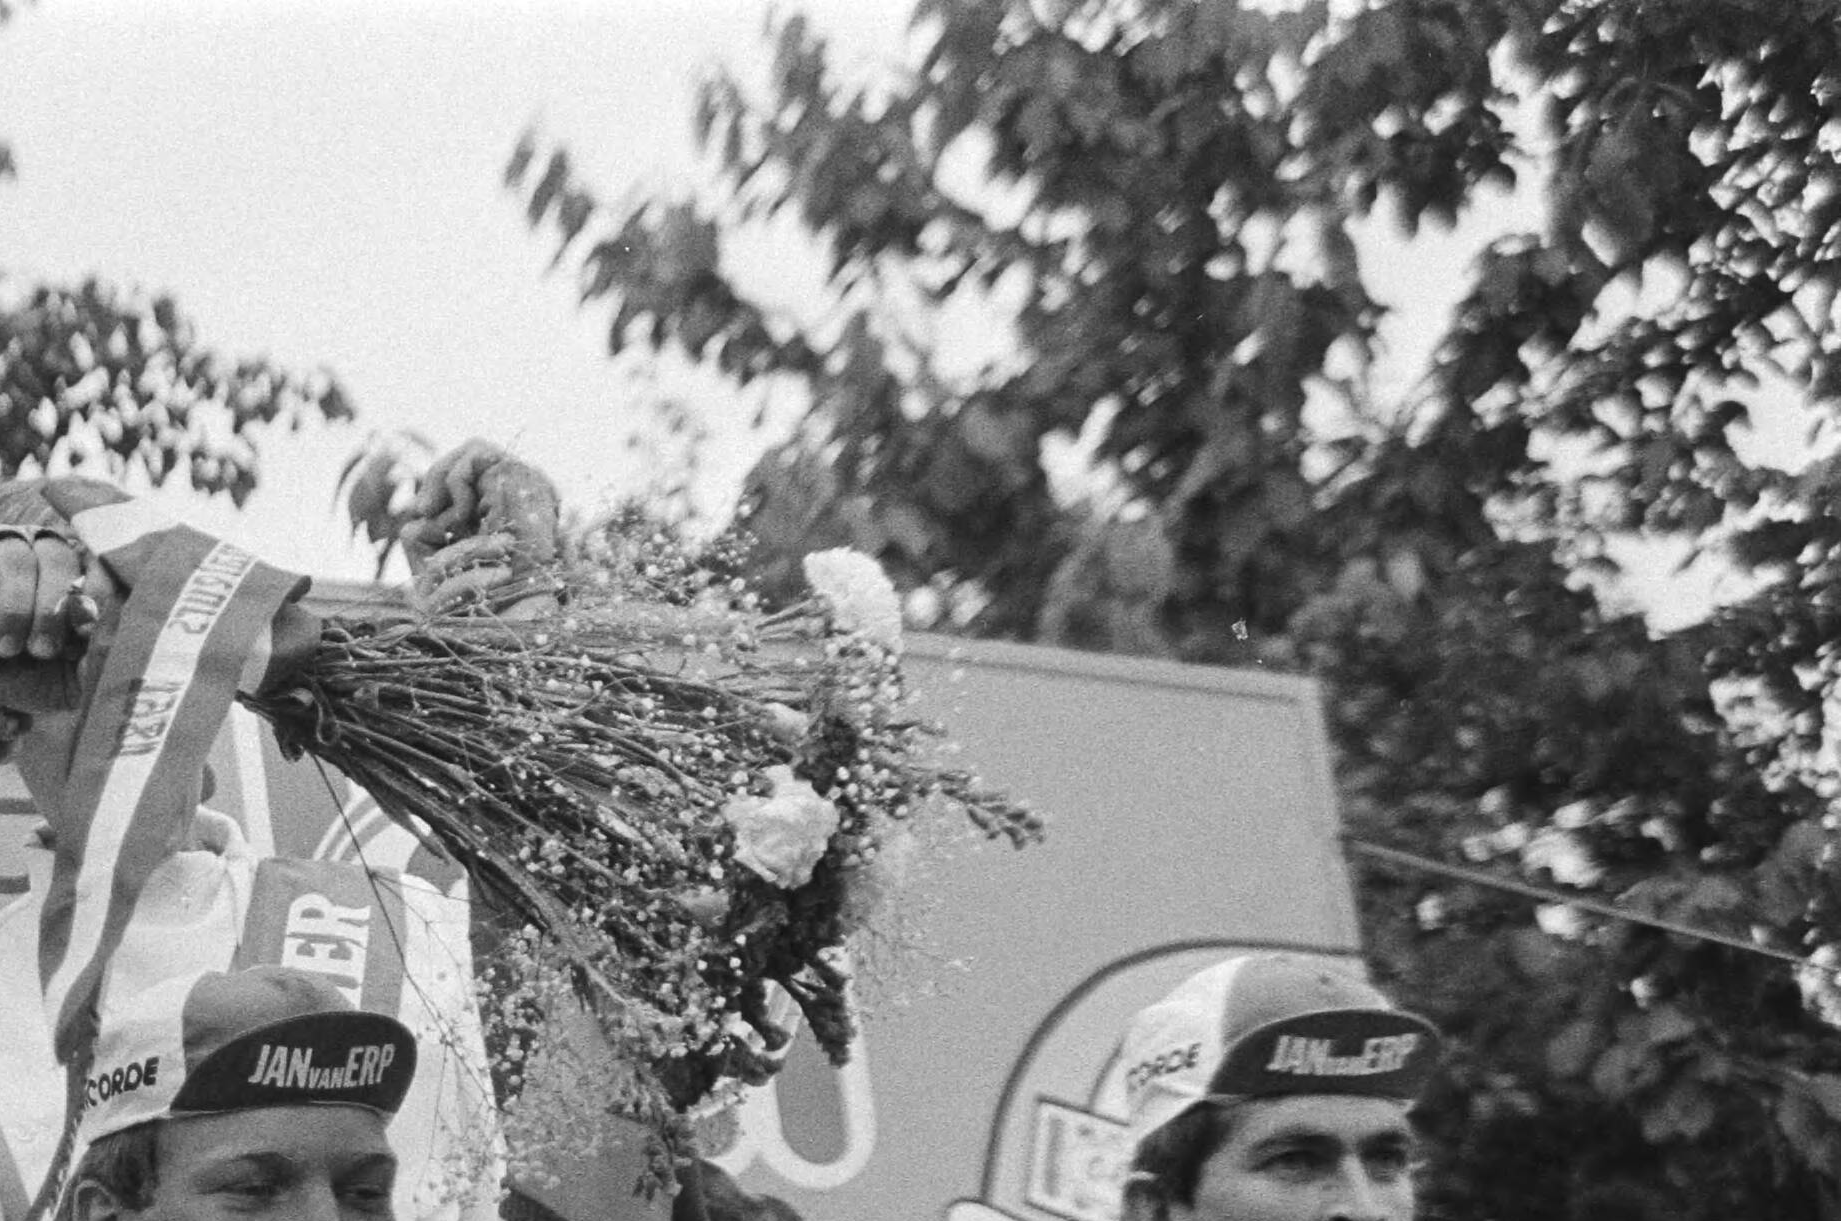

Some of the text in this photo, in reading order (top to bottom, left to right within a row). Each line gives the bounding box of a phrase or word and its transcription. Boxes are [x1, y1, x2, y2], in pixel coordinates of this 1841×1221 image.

[82, 1056, 159, 1108] CORDE
[247, 1043, 315, 1088] JAN
[343, 1043, 396, 1087] ERP
